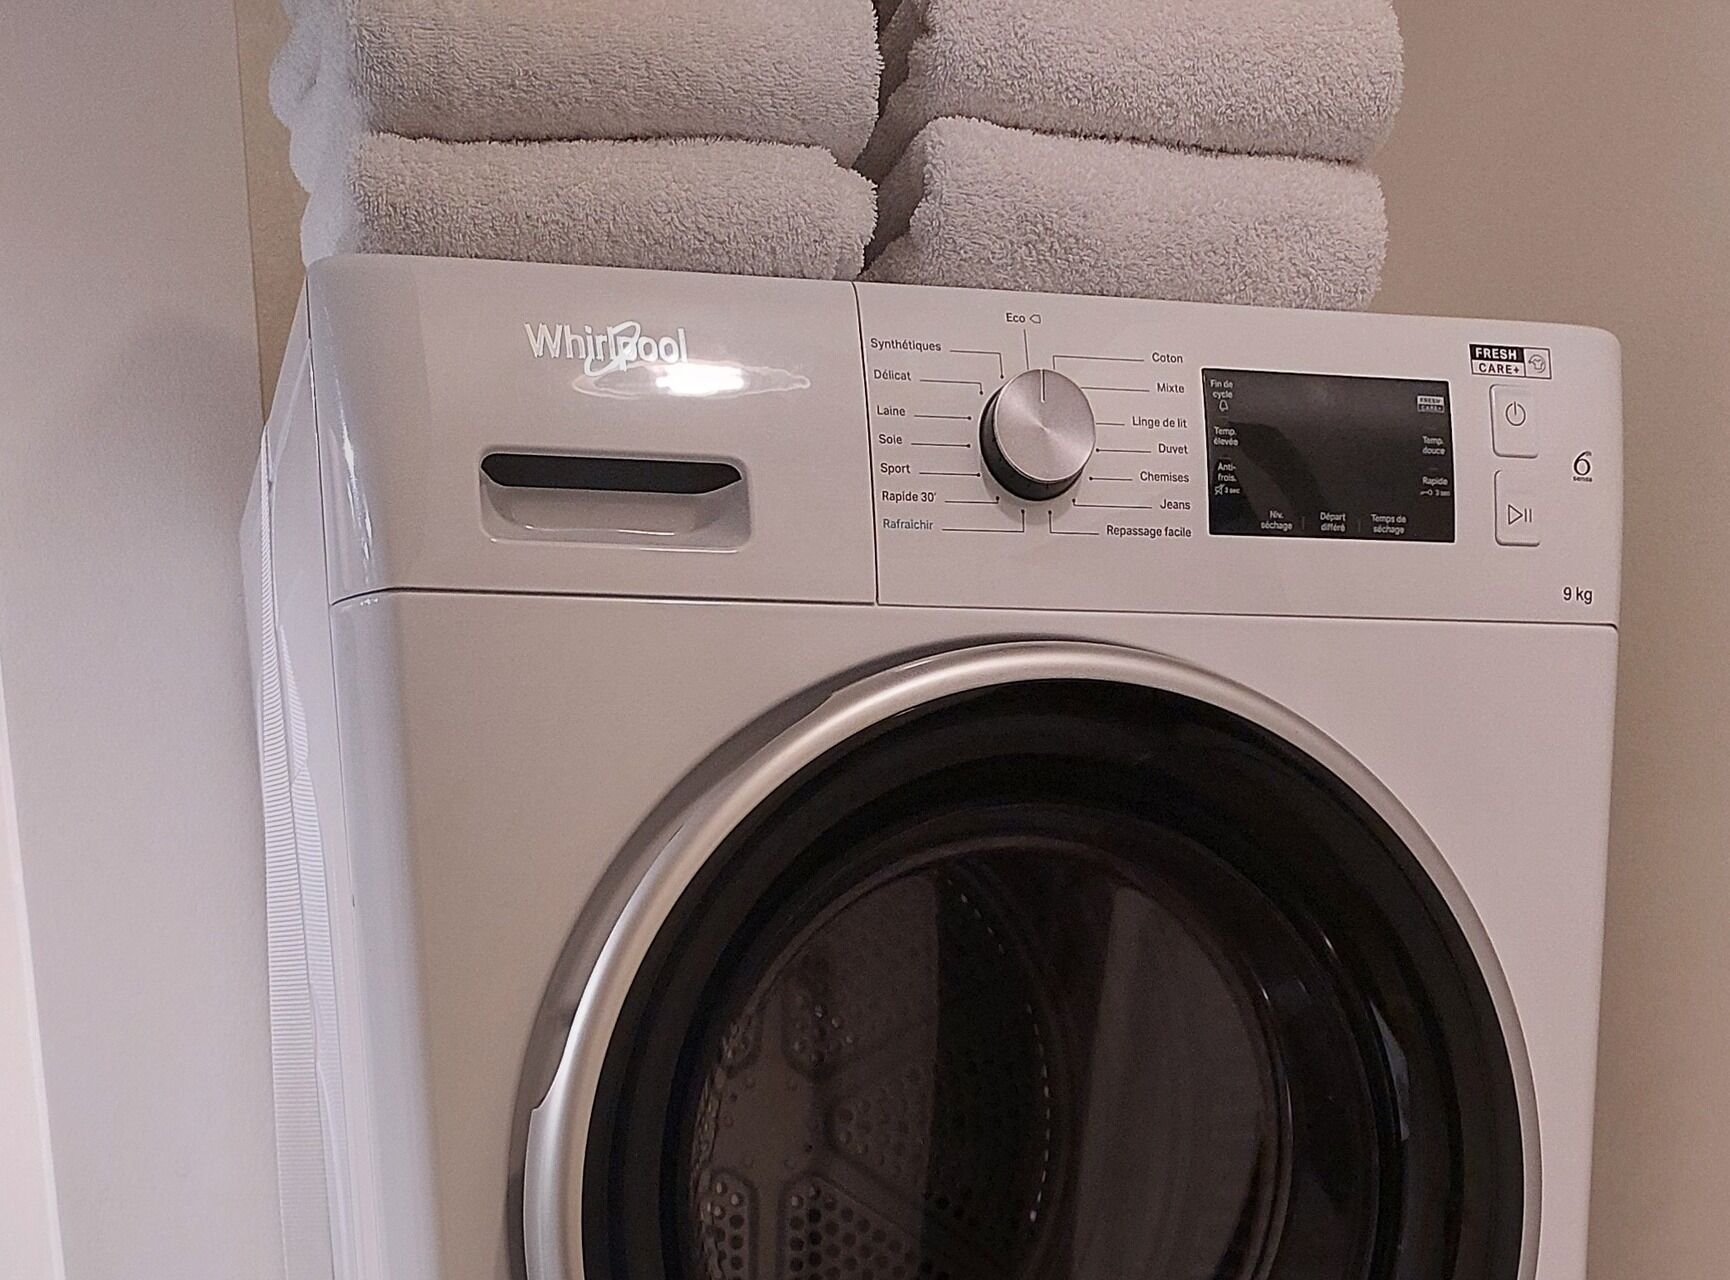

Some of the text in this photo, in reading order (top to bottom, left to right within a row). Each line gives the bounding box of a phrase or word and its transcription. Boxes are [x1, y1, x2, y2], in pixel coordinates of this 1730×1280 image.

[1006, 313, 1026, 323] Eco
[524, 320, 689, 378] Whirlpool
[870, 337, 942, 352] Synthétiques
[1152, 352, 1183, 364] Coton
[1475, 347, 1518, 361] FRESH
[1478, 362, 1521, 375] CARE+
[873, 369, 912, 381] Délicat
[1157, 382, 1185, 394] Mixte
[1210, 379, 1234, 389] Fin de
[1212, 390, 1234, 400] cycle
[877, 404, 906, 416] Laine
[1132, 416, 1188, 429] Linge de lit
[1214, 426, 1237, 437] Temp.
[878, 433, 903, 445] Soie
[1213, 437, 1239, 446] élevée
[1422, 436, 1444, 446] Temp.
[1158, 443, 1188, 455] Duvet
[1422, 446, 1446, 455] douce
[880, 462, 911, 476] Sport
[1217, 462, 1237, 472] Anti-
[1140, 471, 1190, 484] Chemises
[1422, 476, 1449, 487] Rapide
[882, 490, 937, 503] Rapide 30'
[1160, 499, 1191, 510] Jeans
[1320, 511, 1346, 522] Départ
[1370, 513, 1407, 525] Temps de
[1261, 520, 1293, 531] séchage
[1320, 523, 1346, 533] différé
[1373, 523, 1405, 535] séchage
[1106, 525, 1192, 540] Repassage facile
[1563, 586, 1593, 605] 9 kg
